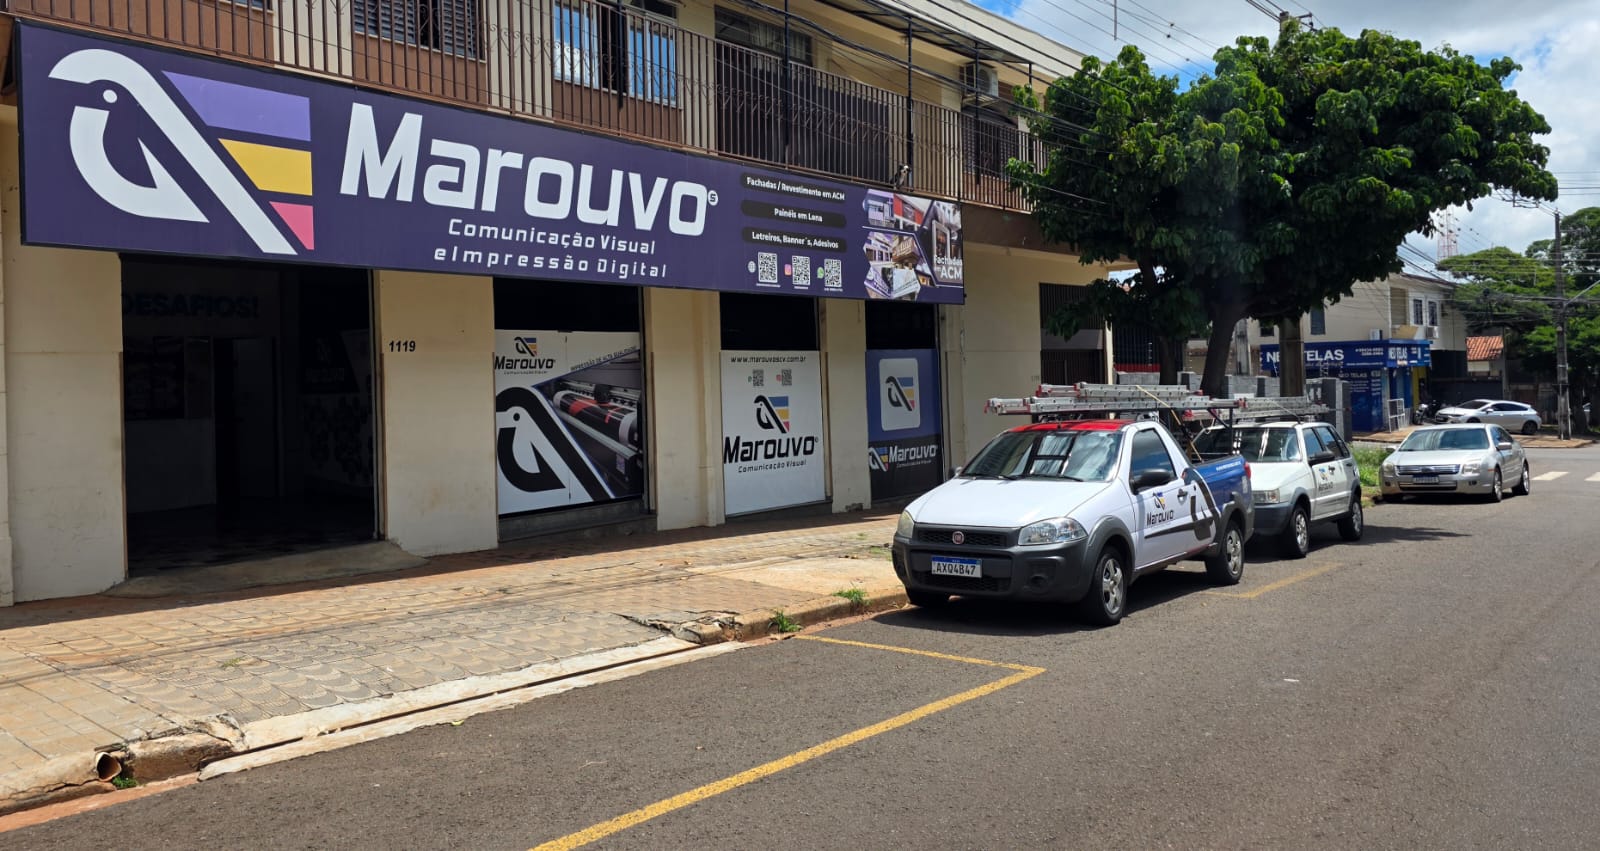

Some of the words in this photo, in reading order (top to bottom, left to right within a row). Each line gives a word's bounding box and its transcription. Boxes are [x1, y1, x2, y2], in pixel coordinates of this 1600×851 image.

[340, 102, 708, 236] Marouvo
[746, 176, 778, 190] Fachadas
[781, 183, 822, 197] Revestimento
[822, 190, 832, 199] em
[832, 191, 846, 201] ACM
[774, 207, 797, 219] Painéis
[798, 212, 808, 220] em
[448, 218, 596, 249] Comunicação
[600, 234, 656, 255] Visual
[752, 231, 782, 243] Letreiros,
[813, 238, 839, 250] Adesivos
[597, 258, 668, 279] Digital
[940, 265, 962, 281] ACM
[388, 340, 416, 352] 1119
[494, 355, 554, 370] Marouvo
[723, 435, 815, 464] Marouvo
[888, 444, 937, 463] Marouvo
[738, 461, 785, 473] Comunicação
[786, 458, 807, 467] Visual
[1146, 510, 1174, 526] Marouvo
